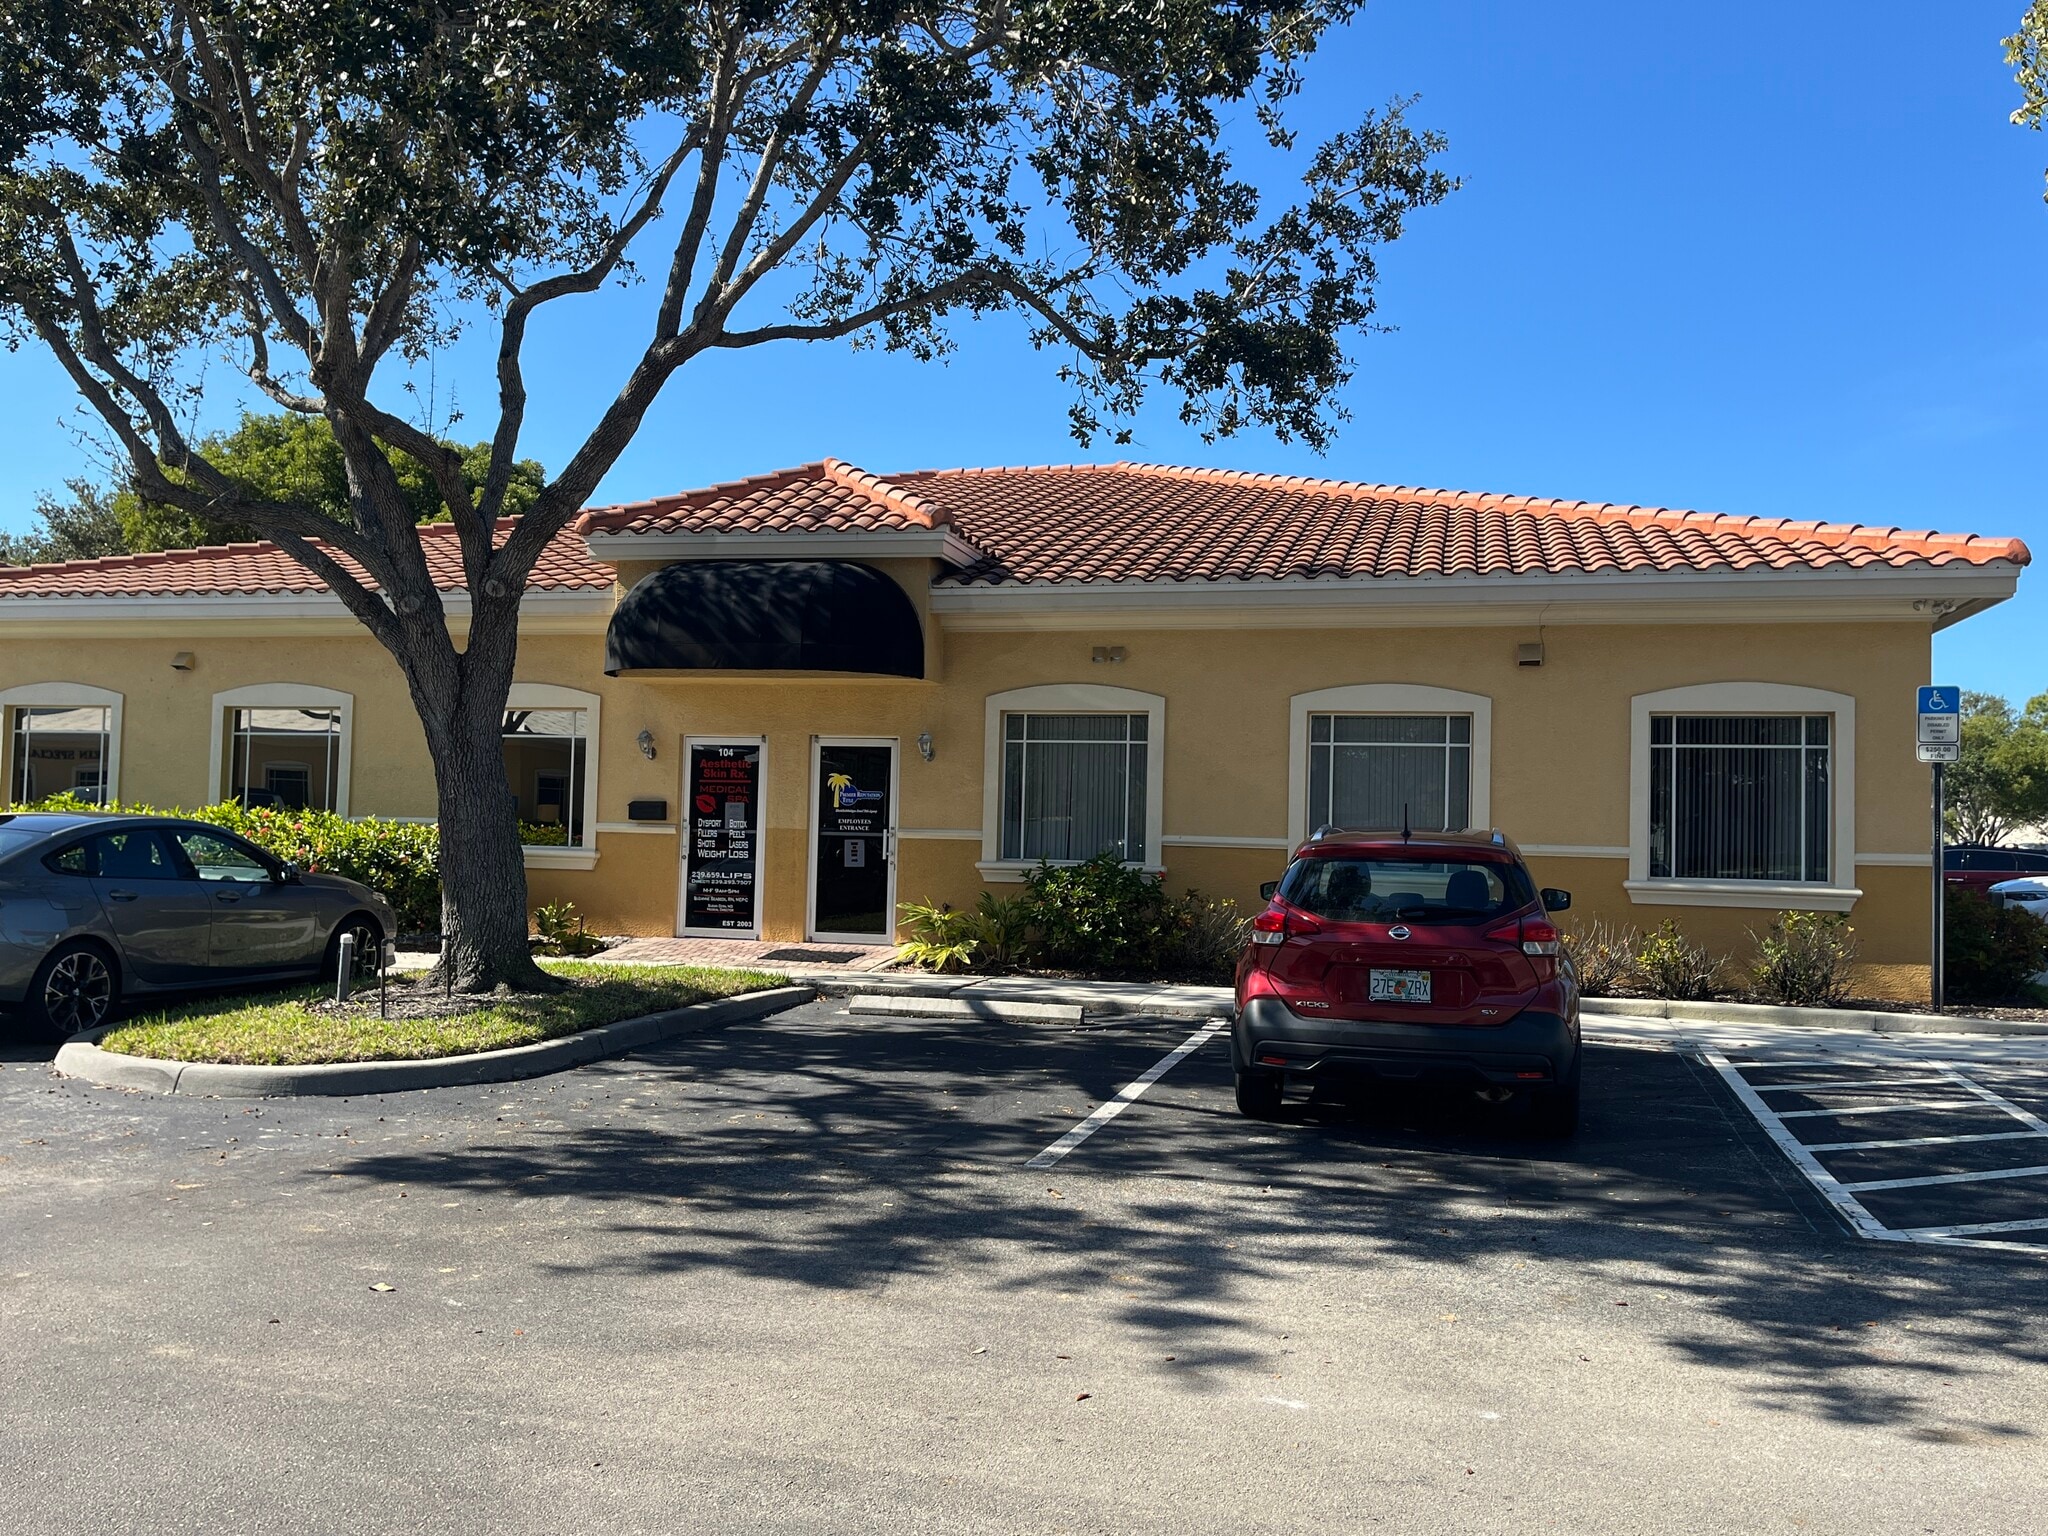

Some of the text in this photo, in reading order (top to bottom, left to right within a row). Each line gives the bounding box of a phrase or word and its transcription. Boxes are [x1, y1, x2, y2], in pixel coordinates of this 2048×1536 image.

[718, 748, 734, 757] 104
[699, 759, 752, 769] Aesthetic
[703, 769, 748, 779] Skin Rx.
[699, 785, 750, 794] MEDICAL
[726, 795, 750, 804] SPA
[697, 848, 749, 859] WEIGHT LOSS
[1372, 978, 1429, 996] 27E ZRX
[1295, 1000, 1329, 1008] KICKS
